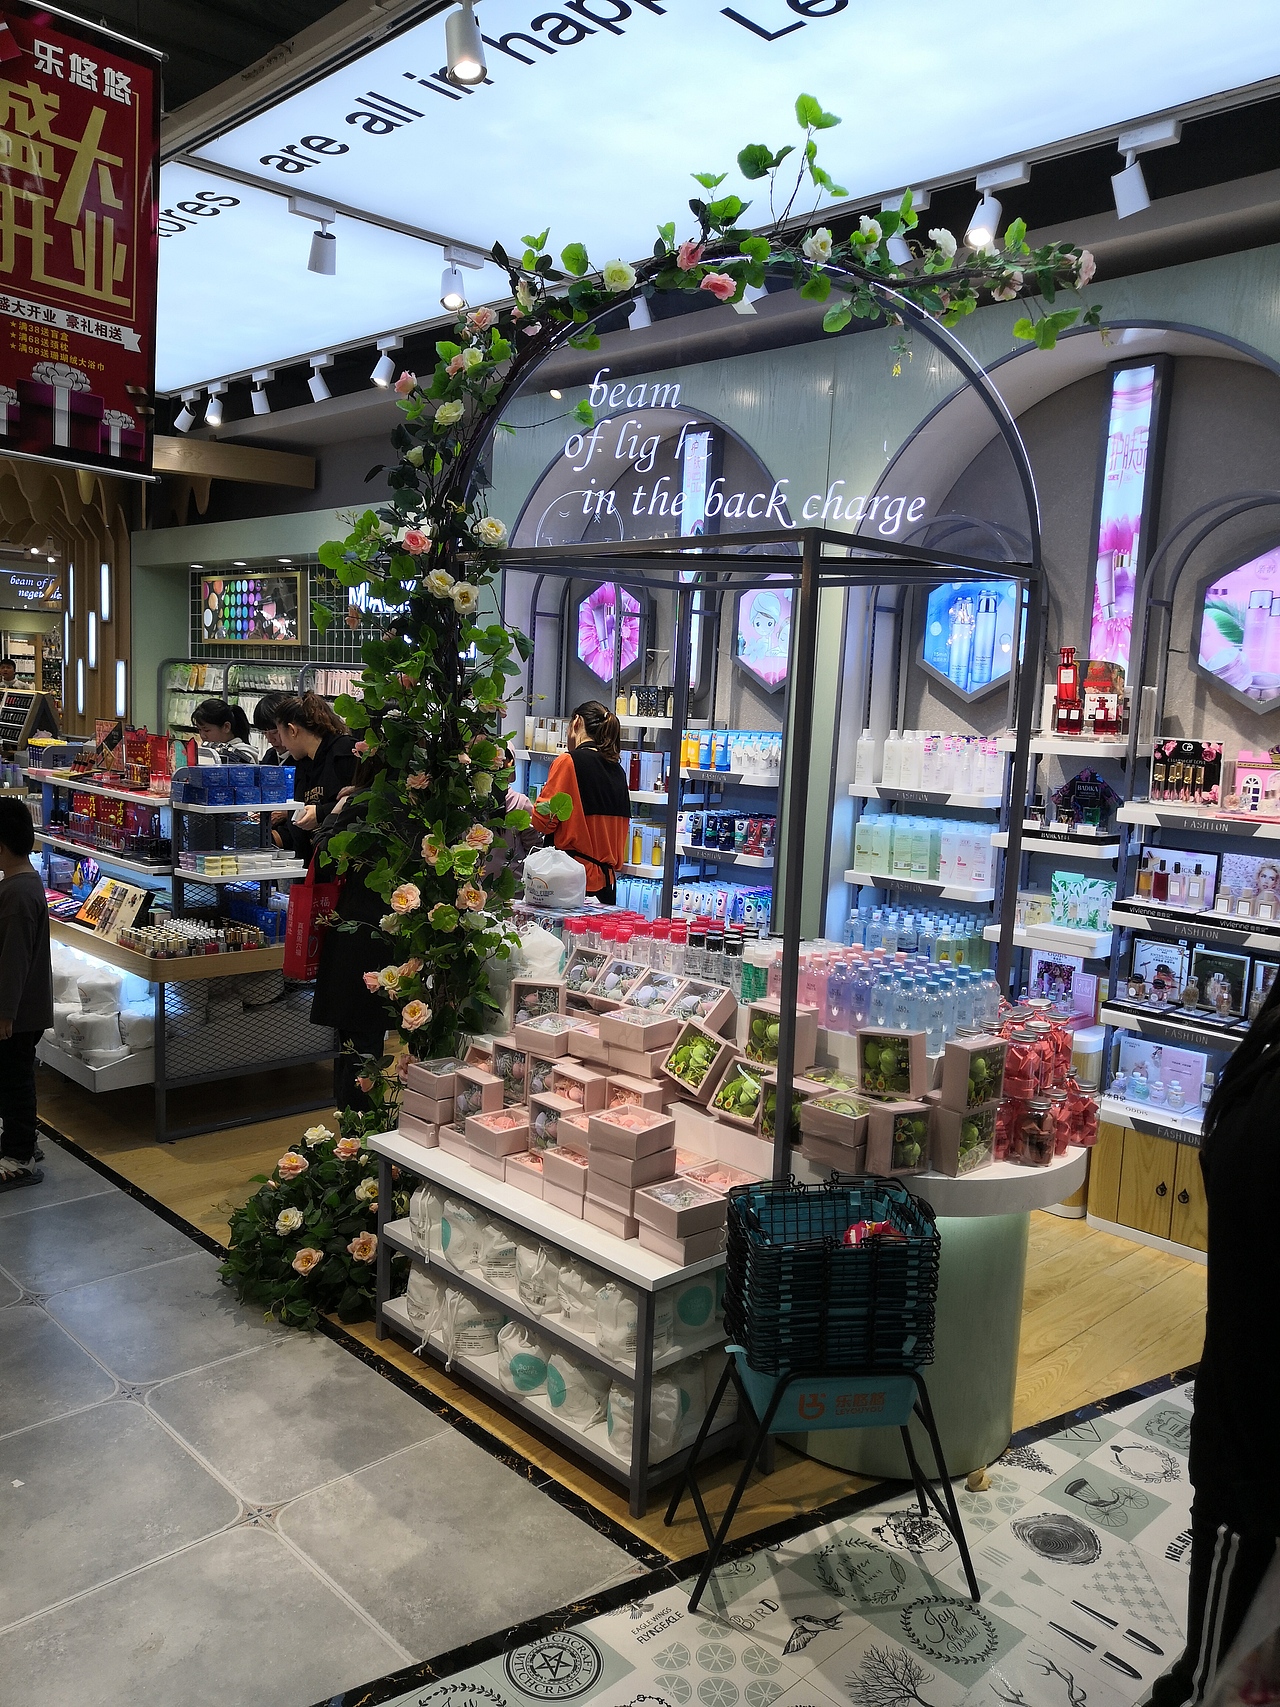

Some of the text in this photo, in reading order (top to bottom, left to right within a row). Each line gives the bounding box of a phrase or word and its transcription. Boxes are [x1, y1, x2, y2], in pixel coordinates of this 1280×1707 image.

[34, 38, 132, 106] 乐悠悠
[259, 135, 350, 174] are
[345, 91, 426, 135] all
[480, 0, 668, 65] hap
[18, 321, 69, 342] 满38送盲盒
[65, 314, 123, 341] 豪礼相送
[589, 368, 681, 408] beam
[564, 420, 612, 472] of
[581, 476, 926, 535] in the back charge
[10, 574, 49, 590] beam of
[1183, 820, 1229, 832] FASHION
[890, 881, 923, 893] FASHION
[1174, 925, 1220, 940] FASHION
[1164, 1028, 1209, 1045] FASHION
[1157, 1127, 1201, 1146] FASHION
[631, 1606, 673, 1636] EAGLE WINGS
[924, 1606, 958, 1644] Joy
[514, 1652, 583, 1694] WITCHCRAFT
